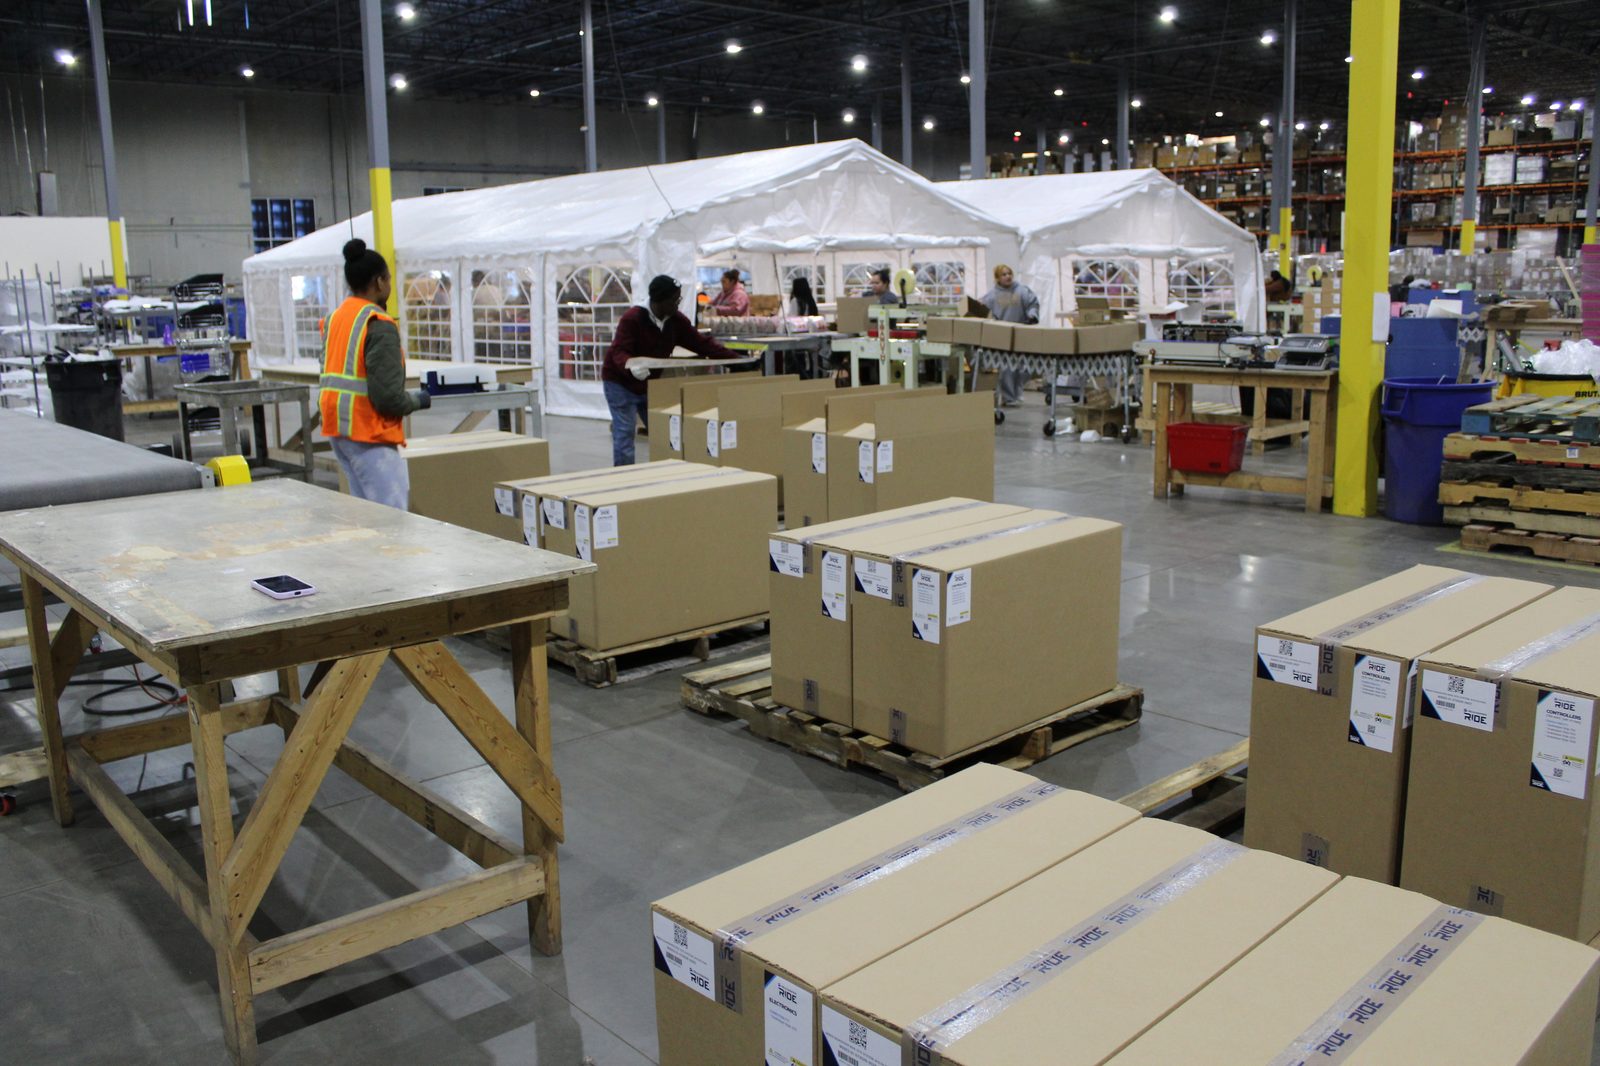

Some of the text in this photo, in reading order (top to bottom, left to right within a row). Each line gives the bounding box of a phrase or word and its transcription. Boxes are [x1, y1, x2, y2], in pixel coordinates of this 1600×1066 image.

[1575, 390, 1600, 398] BRUT
[1322, 643, 1334, 674] RIDE
[1361, 671, 1392, 681] CONTROLLERS
[1367, 663, 1387, 674] RIDE
[1293, 673, 1313, 684] RIDE
[1554, 700, 1576, 712] RIDE
[1463, 711, 1488, 725] RIDE
[1546, 709, 1583, 720] CONTROLLERS
[965, 812, 999, 828] RIDE
[1000, 796, 1032, 812] RIDE
[1032, 950, 1072, 975] RIDE
[1072, 926, 1110, 949] RIDE
[1108, 904, 1145, 925] RIDE
[689, 972, 711, 992] RIDE
[1315, 920, 1464, 1057] RIDE RIDE RIDE RIDE RIDE
[778, 987, 798, 1005] RIDE
[769, 996, 798, 1017] ELECTRONICS
